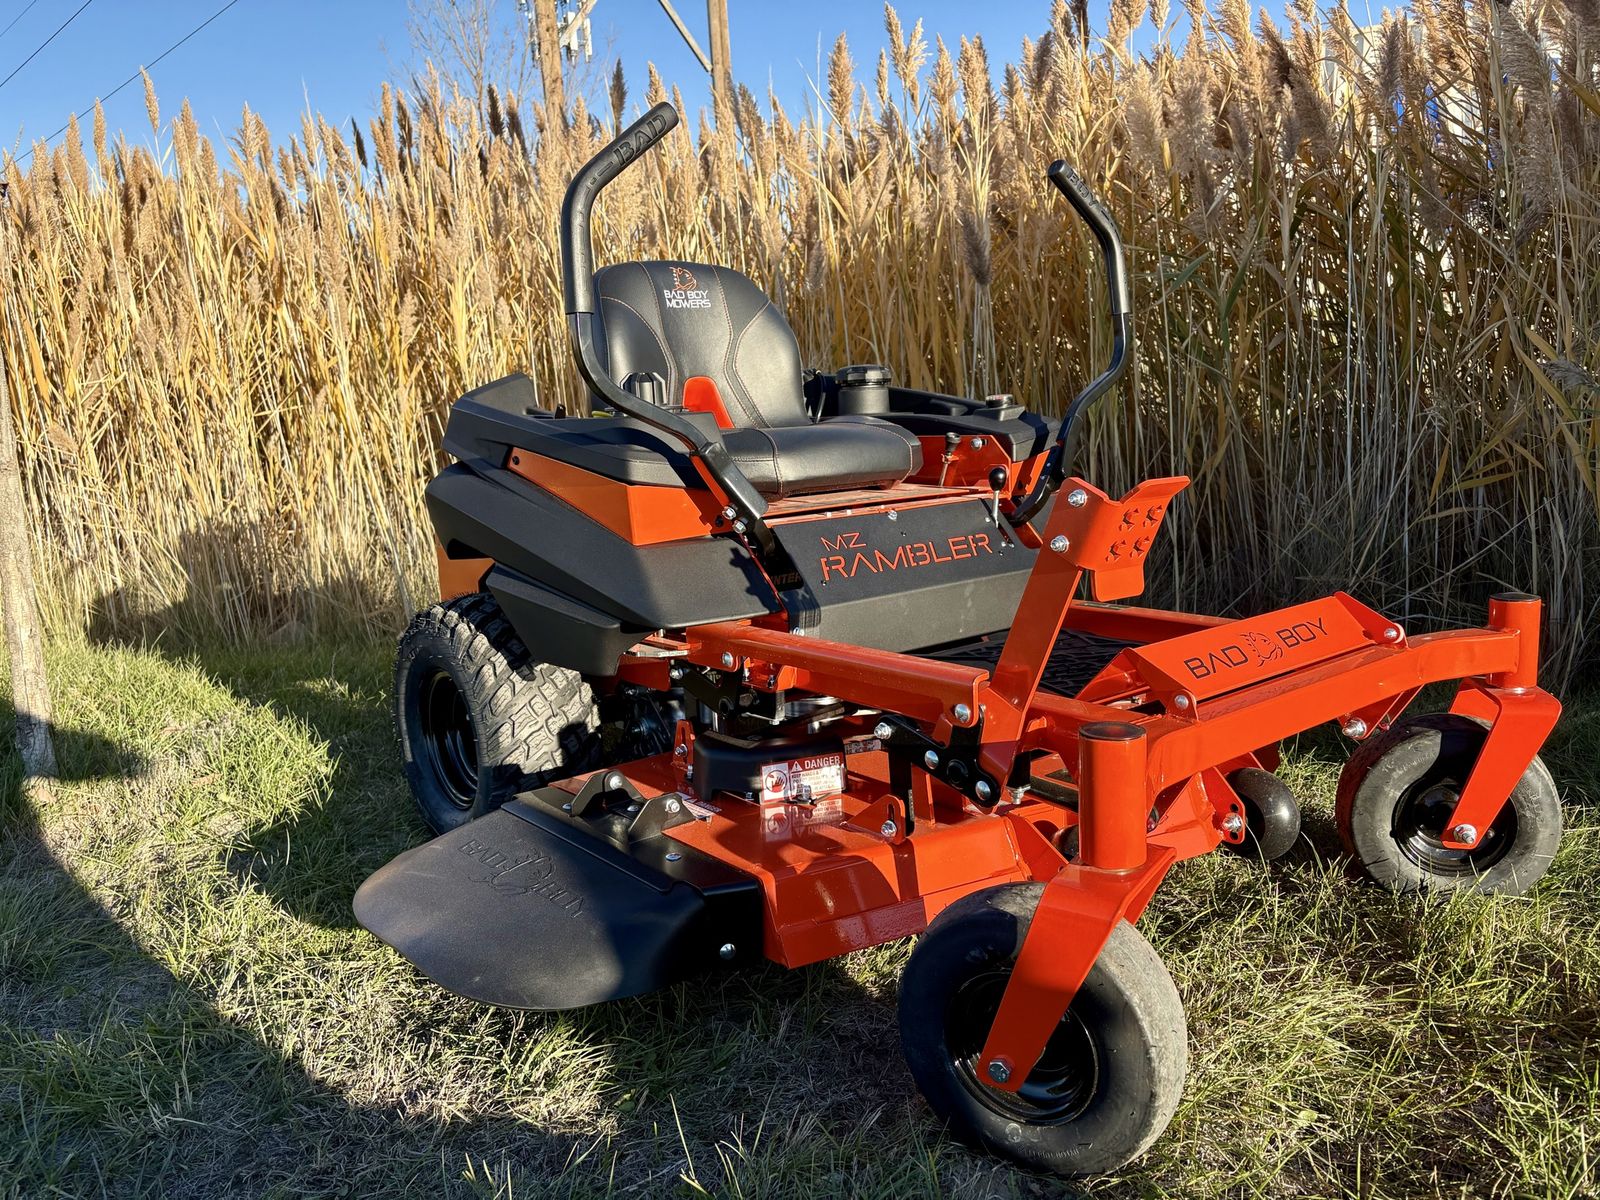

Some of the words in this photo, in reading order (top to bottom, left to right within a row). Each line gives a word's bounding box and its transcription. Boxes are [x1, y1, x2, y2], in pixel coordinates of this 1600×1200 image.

[613, 114, 667, 167] BAD
[1067, 168, 1099, 207] BOY
[663, 289, 685, 299] BAD
[686, 289, 708, 299] BOY
[665, 299, 712, 309] MOWERS
[820, 532, 867, 552] MZ
[820, 533, 993, 581] RAMBLER
[1183, 644, 1249, 680] BAD
[1275, 617, 1328, 649] BOY
[804, 755, 841, 770] DANGER
[457, 839, 508, 869] BAD
